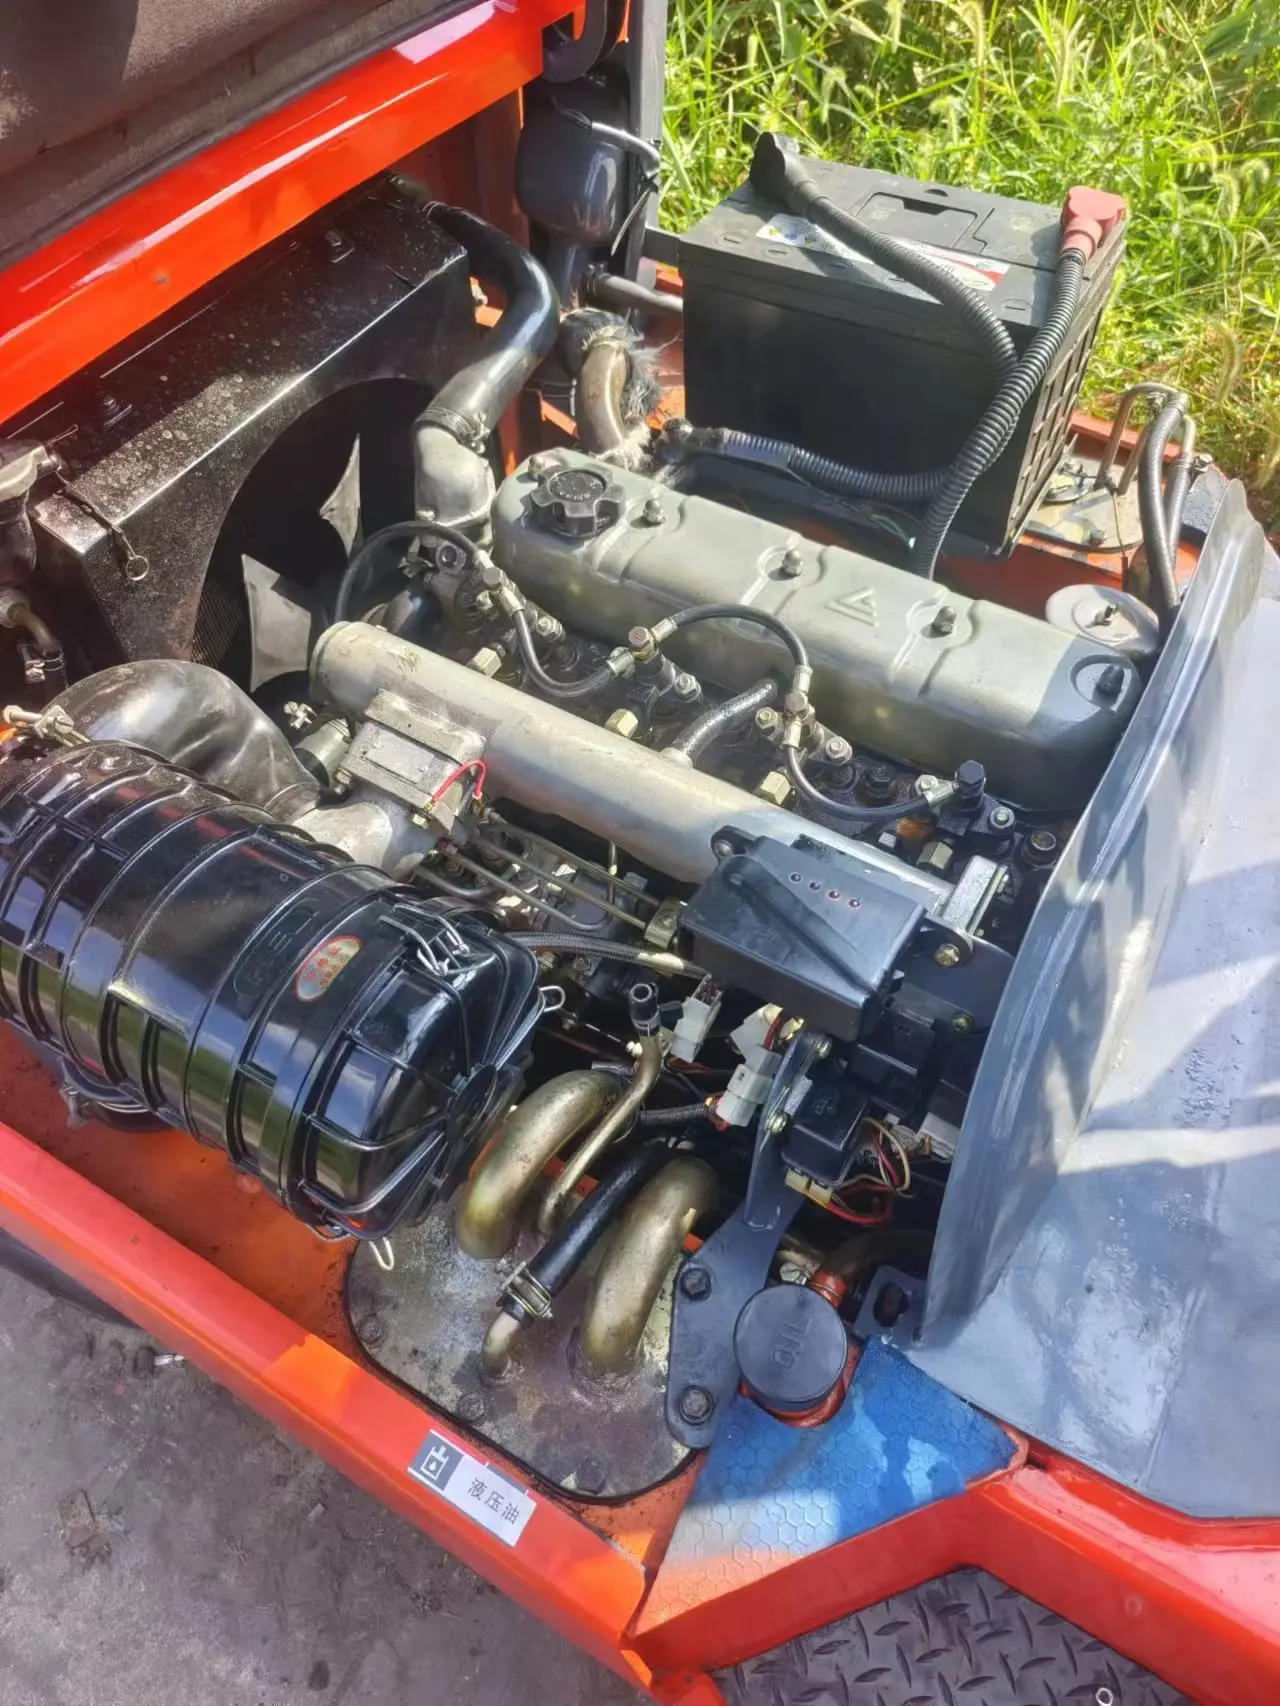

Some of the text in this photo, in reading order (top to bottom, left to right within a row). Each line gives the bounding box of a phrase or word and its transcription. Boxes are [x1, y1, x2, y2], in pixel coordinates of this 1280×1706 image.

[773, 1317, 814, 1370] OIL
[467, 1477, 520, 1525] 液压油
